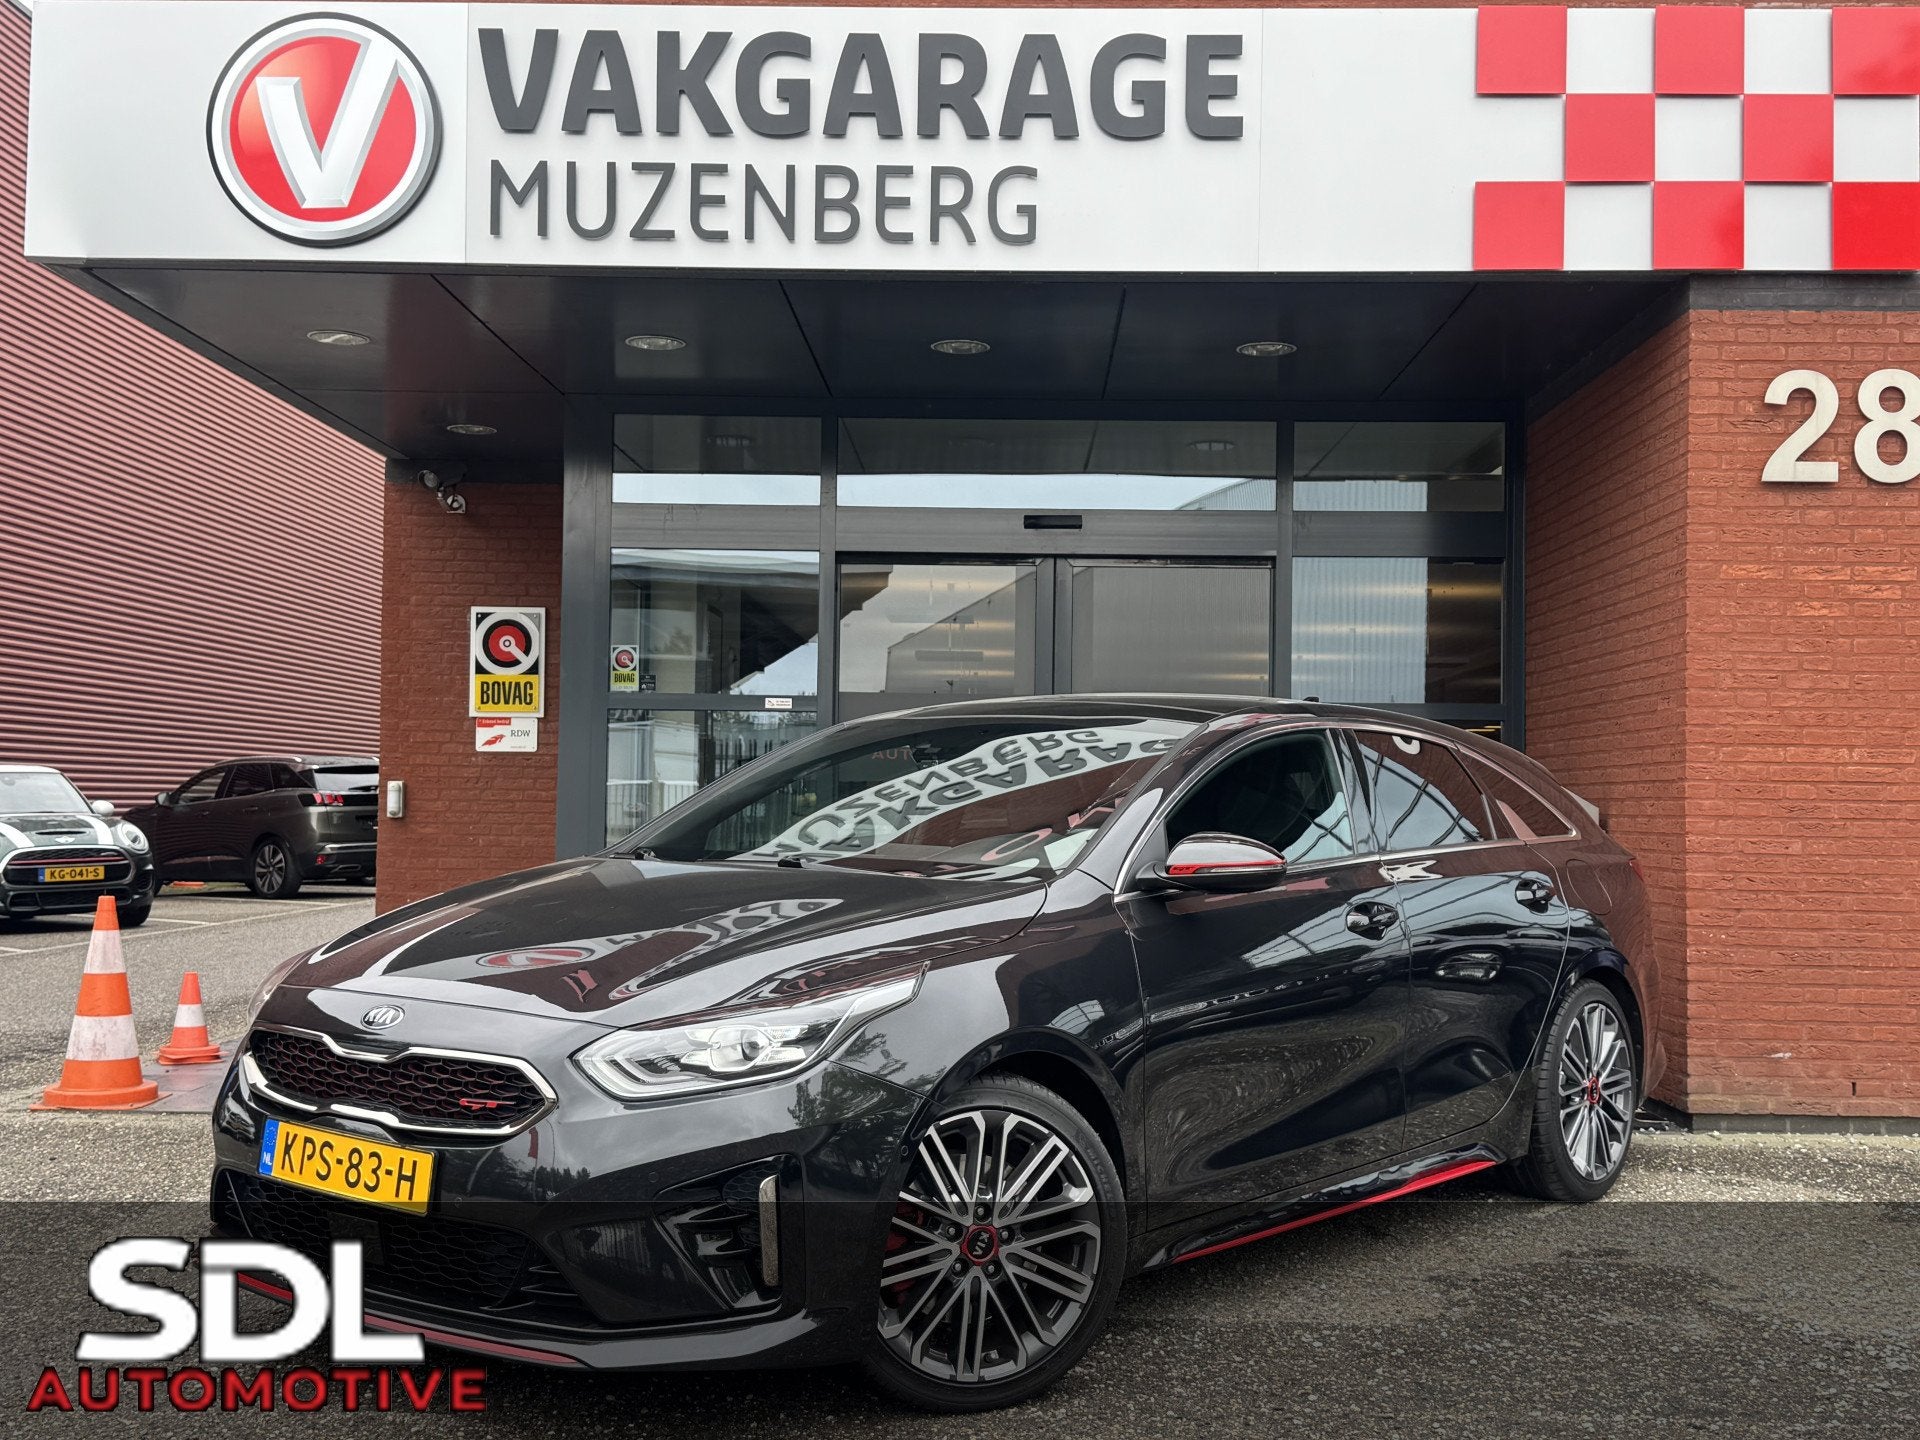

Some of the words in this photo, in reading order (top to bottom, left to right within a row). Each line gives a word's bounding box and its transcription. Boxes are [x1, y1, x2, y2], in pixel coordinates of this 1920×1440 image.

[477, 27, 1245, 140] VAKGARAGE
[490, 159, 1038, 246] MUZENBERG
[1761, 368, 1920, 484] 28
[614, 672, 635, 683] BOVAG
[480, 680, 533, 705] BOVAG
[510, 729, 531, 737] RDW
[49, 867, 100, 880] KG-041-S
[364, 1006, 397, 1025] KIA
[262, 1151, 273, 1166] NL
[280, 1130, 418, 1202] KPS-83-H
